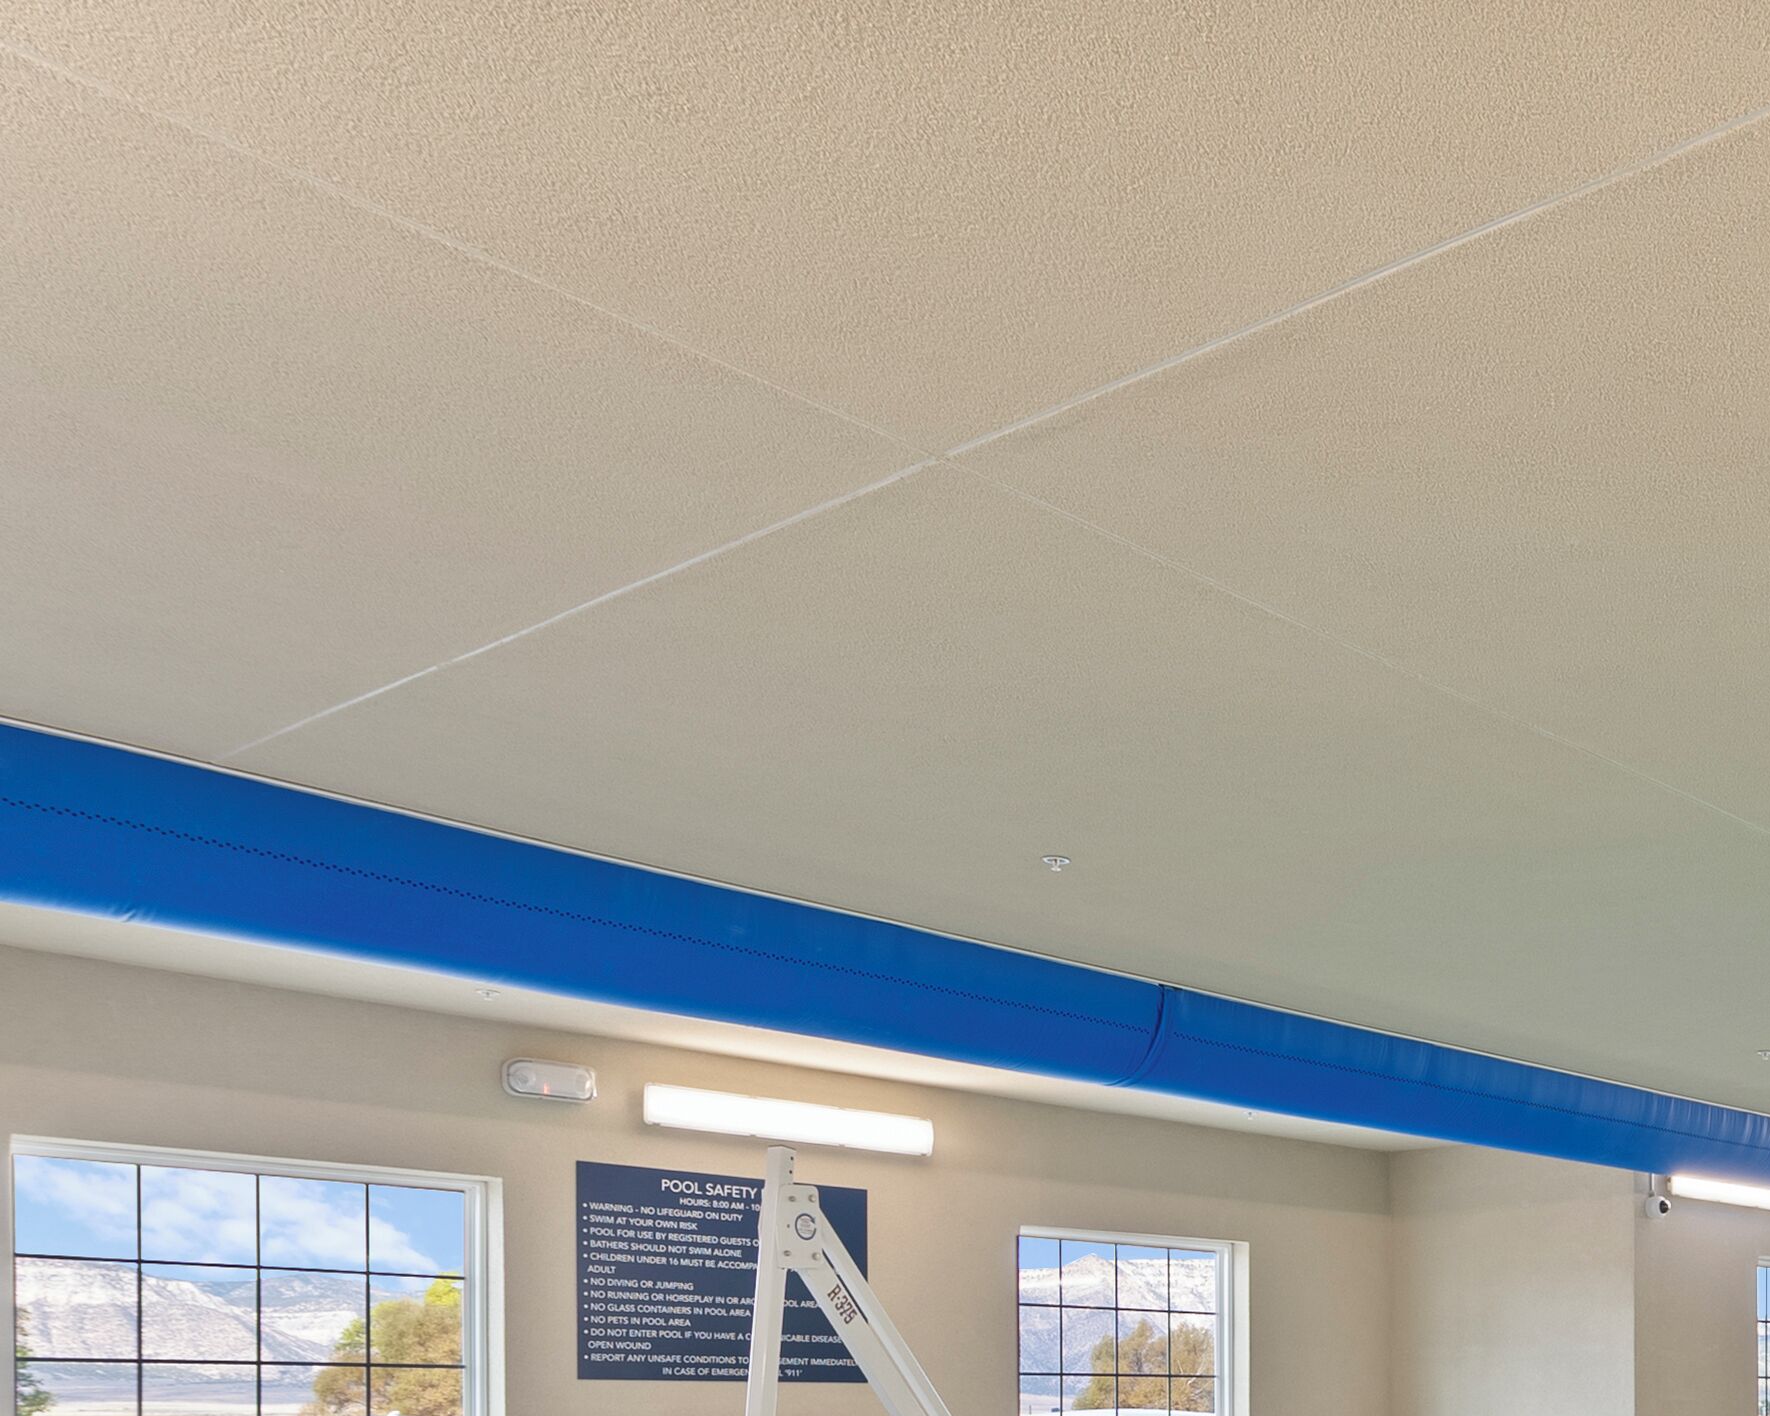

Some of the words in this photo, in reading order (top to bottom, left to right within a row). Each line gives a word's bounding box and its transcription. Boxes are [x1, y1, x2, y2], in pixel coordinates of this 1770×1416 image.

[661, 1179, 702, 1195] POOL
[706, 1183, 758, 1199] SAFETY
[680, 1198, 711, 1208] HOURS:
[712, 1200, 729, 1209] 8:00
[730, 1202, 744, 1210] AM
[589, 1202, 633, 1213] WARNING
[640, 1206, 655, 1215] NO
[657, 1208, 704, 1219] LIFEGUARD
[705, 1212, 719, 1220] ON
[720, 1213, 743, 1222] DUTY
[589, 1214, 614, 1224] SWIM
[616, 1216, 627, 1225] AT
[628, 1217, 654, 1227] YOUR
[655, 1220, 678, 1229] OWN
[679, 1221, 698, 1230] RISK
[589, 1227, 615, 1237] POOL
[616, 1229, 635, 1238] FOR
[637, 1231, 654, 1239] USE
[655, 1232, 667, 1240] BY
[668, 1233, 718, 1244] REGISTERED
[720, 1237, 751, 1247] GUESTS
[590, 1239, 629, 1250] BATHERS
[630, 1242, 667, 1252] SHOULD
[668, 1245, 687, 1254] NOT
[688, 1246, 712, 1255] SWIM
[713, 1248, 742, 1257] ALONE
[590, 1252, 635, 1263] CHILDREN
[636, 1255, 667, 1265] UNDER
[669, 1257, 679, 1266] 16
[680, 1258, 704, 1267] MUST
[705, 1259, 716, 1268] BE
[587, 1265, 616, 1274] ADULT
[590, 1277, 606, 1286] NO
[607, 1278, 639, 1288] DIVING
[640, 1280, 654, 1289] OR
[655, 1281, 694, 1291] JUMPING
[590, 1290, 606, 1299] NO
[607, 1291, 649, 1301] RUNNING
[651, 1293, 665, 1301] OR
[666, 1294, 714, 1303] HORSEPLAY
[715, 1296, 725, 1304] IN
[726, 1297, 739, 1305] OR
[590, 1303, 606, 1311] NO
[607, 1303, 636, 1313] GLASS
[637, 1305, 692, 1315] CONTAINERS
[693, 1307, 703, 1315] IN
[704, 1308, 728, 1316] POOL
[729, 1309, 752, 1317] AREA
[590, 1315, 606, 1324] NO
[607, 1316, 629, 1325] PETS
[630, 1317, 641, 1325] IN
[642, 1317, 667, 1326] POOL
[668, 1318, 691, 1327] AREA
[590, 1328, 606, 1337] DO
[607, 1328, 628, 1337] NOT
[629, 1329, 658, 1338] ENTER
[659, 1330, 683, 1339] POOL
[684, 1331, 693, 1339] IF
[693, 1331, 712, 1339] YOU
[713, 1332, 736, 1340] HAVE
[737, 1333, 744, 1341] A
[587, 1340, 614, 1349] OPEN
[615, 1341, 652, 1350] WOUND
[590, 1353, 625, 1362] REPORT
[626, 1354, 647, 1362] ANY
[648, 1354, 682, 1363] UNSAFE
[683, 1355, 737, 1364] CONDITIONS
[738, 1356, 750, 1365] TO
[810, 1358, 858, 1367] IMMEDIATEL
[662, 1367, 672, 1376] IN
[673, 1367, 696, 1376] CASE
[697, 1368, 710, 1376] OF
[711, 1368, 749, 1376] EMERGEN
